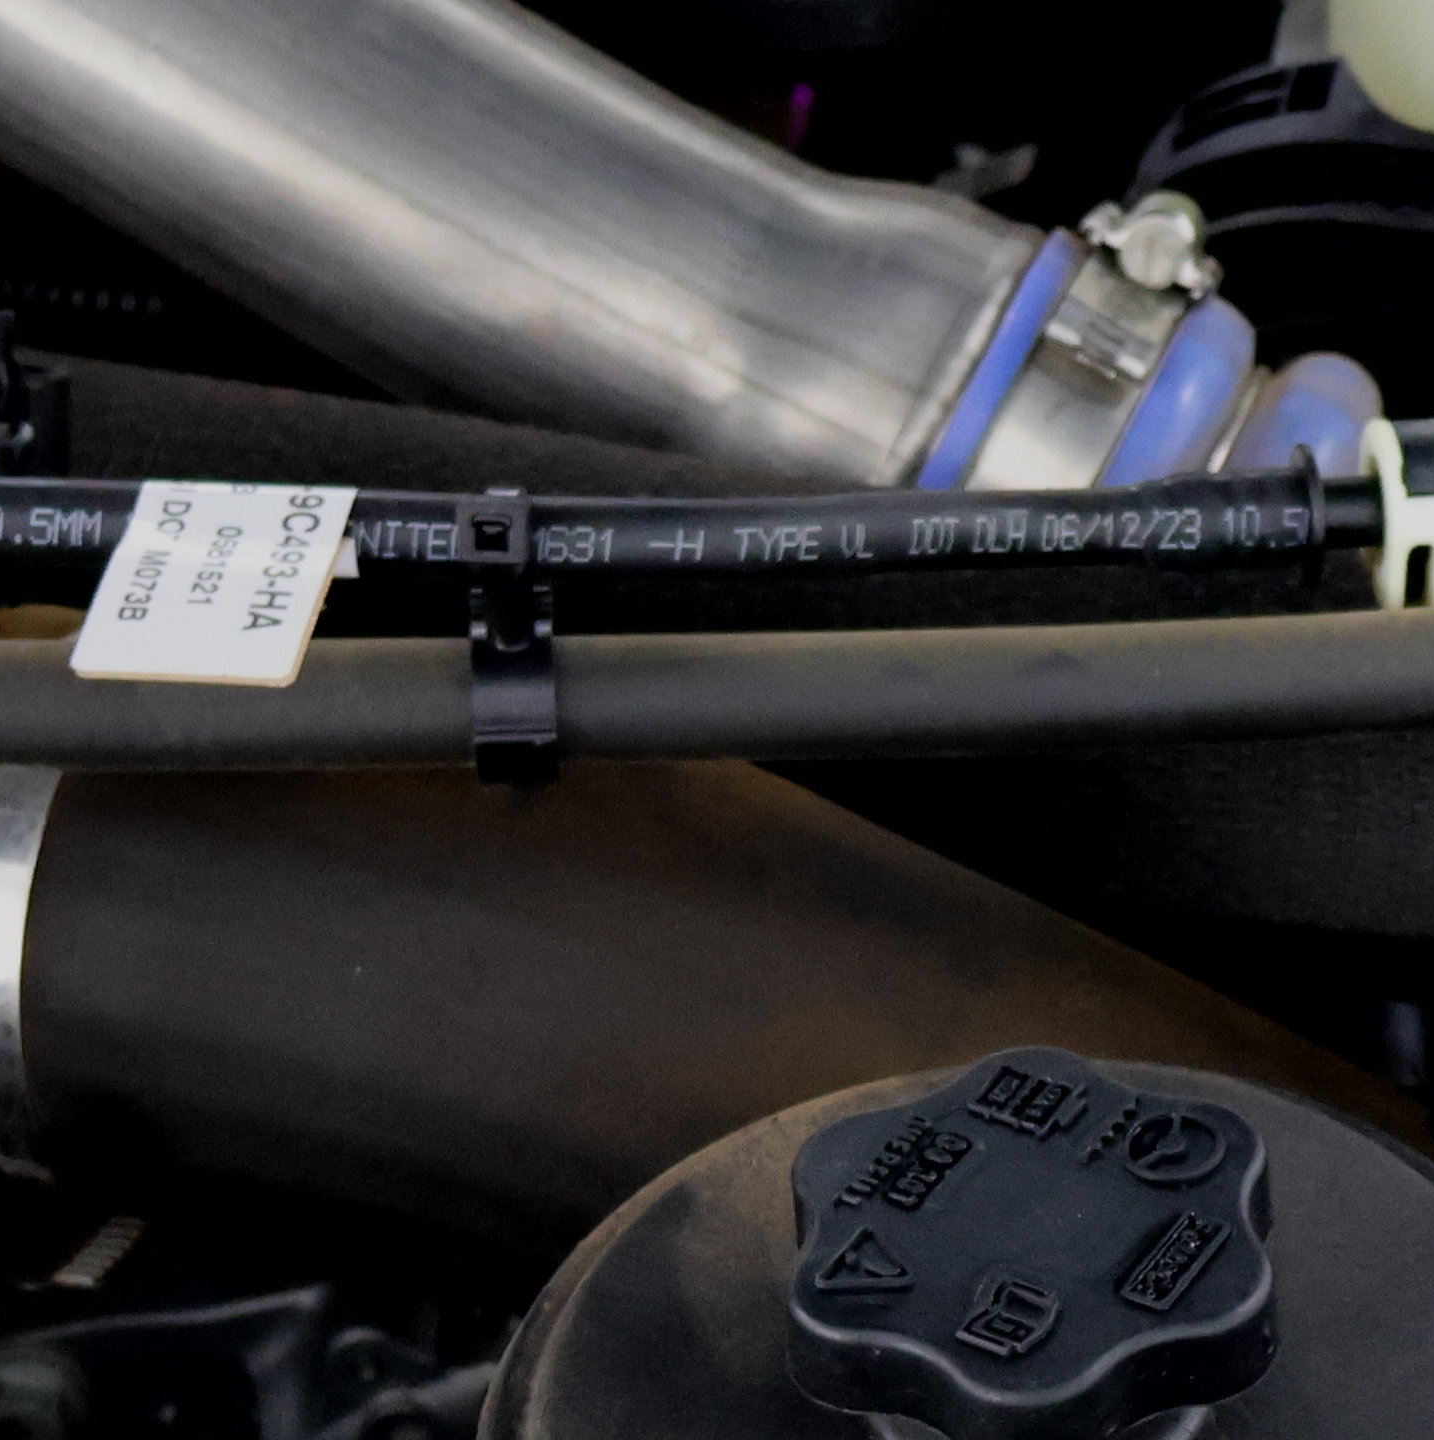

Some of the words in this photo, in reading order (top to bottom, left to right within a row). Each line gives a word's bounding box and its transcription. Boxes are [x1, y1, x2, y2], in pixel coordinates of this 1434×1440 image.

[354, 521, 459, 560] NITE
[733, 525, 823, 562] TYPE
[908, 517, 961, 556] DOT
[1040, 507, 1203, 552] 06/12/23
[117, 550, 171, 622] M073B
